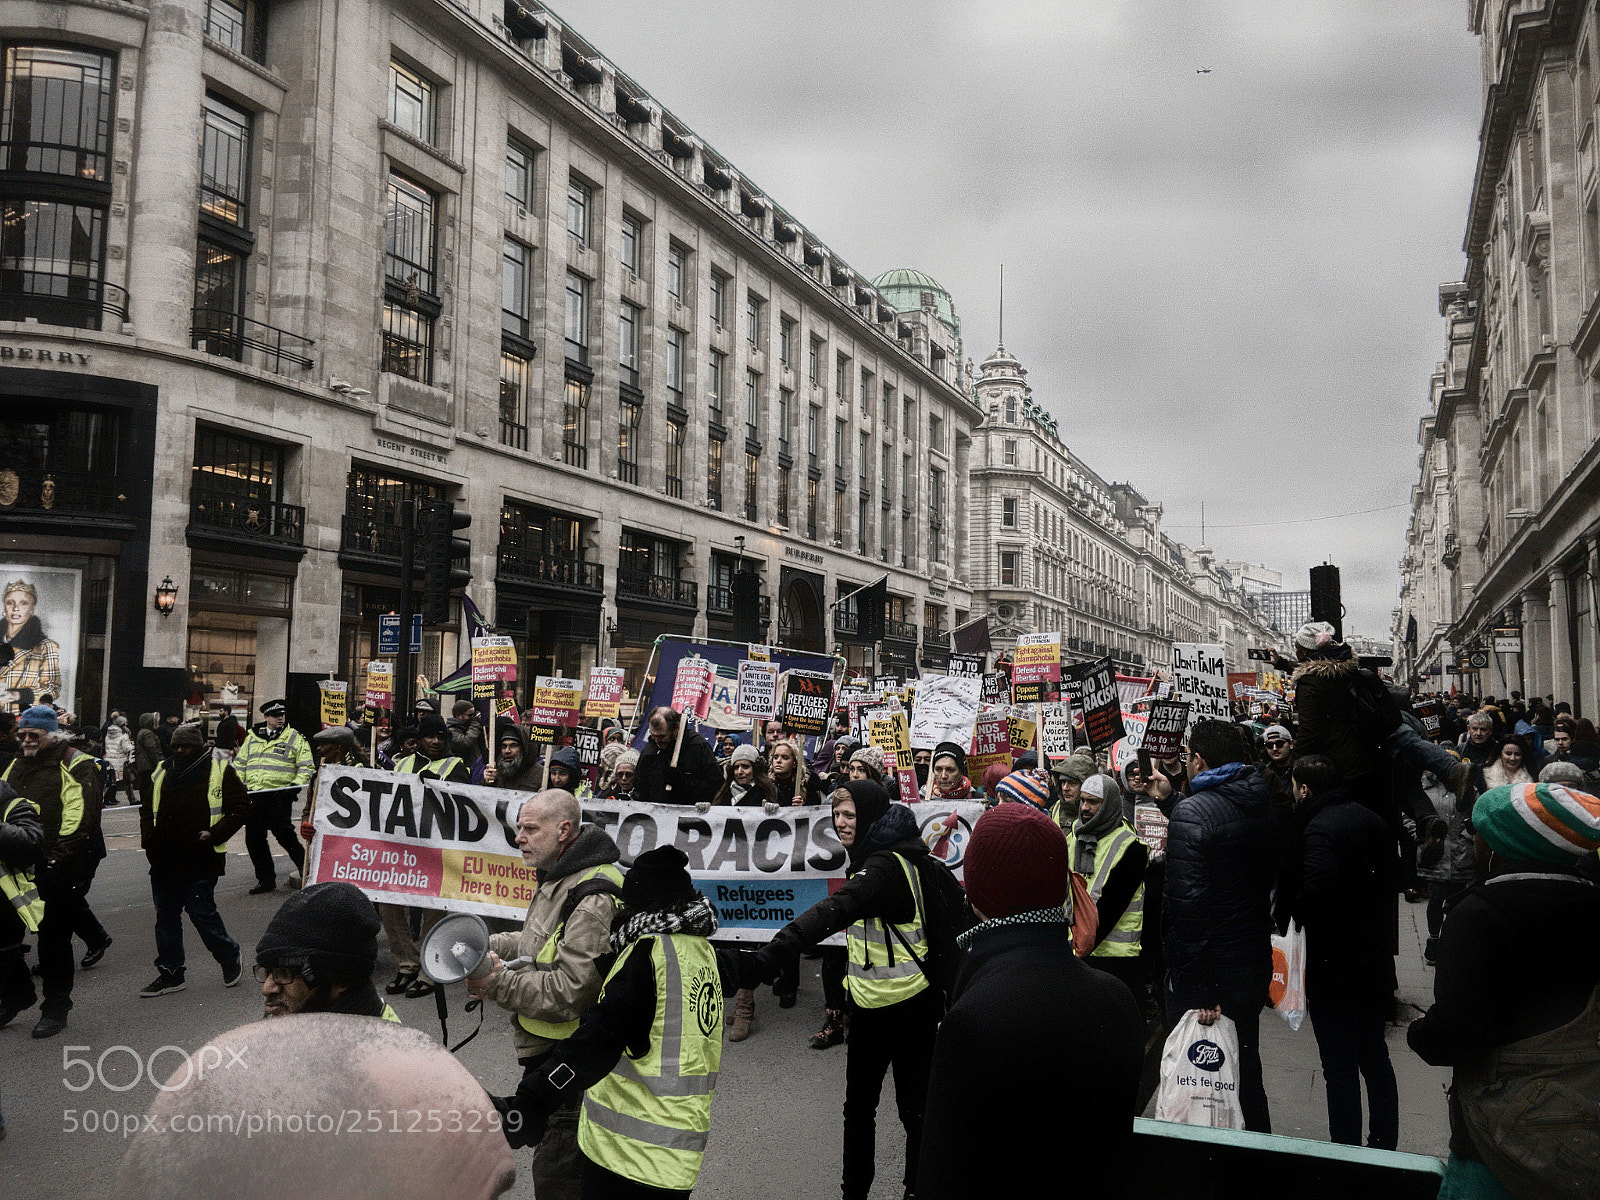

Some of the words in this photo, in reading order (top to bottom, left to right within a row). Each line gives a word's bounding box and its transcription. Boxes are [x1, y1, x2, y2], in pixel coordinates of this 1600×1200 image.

[377, 438, 406, 453] REGENT
[410, 447, 435, 461] STREET
[785, 546, 825, 565] BURBERRY
[1016, 647, 1030, 655] Fight
[1031, 646, 1053, 655] against
[1016, 654, 1055, 663] Islamophobia
[474, 666, 494, 674] Defend
[495, 665, 506, 673] civil
[949, 660, 963, 670] NO
[965, 661, 978, 672] TO
[1016, 665, 1037, 674] Defend
[1037, 665, 1050, 673] civil
[1215, 657, 1225, 677] 4
[474, 673, 497, 681] liberties
[699, 670, 709, 678] off
[948, 670, 983, 680] RACISM
[1016, 673, 1040, 682] liberties
[591, 676, 617, 685] HANDS
[686, 676, 712, 688] workers
[874, 681, 885, 690] NO
[1081, 677, 1096, 697] NO
[1098, 669, 1110, 689] TO
[474, 684, 495, 692] Oppose
[590, 684, 604, 692] OFF
[605, 685, 620, 693] THE
[680, 682, 709, 694] students
[684, 688, 703, 698] them
[748, 687, 772, 695] SERVICES
[1016, 685, 1039, 694] Oppose
[474, 691, 495, 699] Prevent
[536, 689, 551, 697] Fight
[553, 691, 574, 699] against
[588, 692, 611, 700] HIJAB
[1016, 693, 1039, 701] Prevent
[1083, 682, 1118, 713] RACISM
[535, 696, 574, 706] Islamophobia
[744, 695, 757, 704] NO
[758, 696, 770, 704] TO
[788, 693, 829, 708] REFUGEES
[534, 707, 555, 716] Defend
[556, 709, 569, 718] civil
[740, 704, 772, 713] RACISM
[786, 704, 827, 719] WELCOME
[1152, 705, 1188, 719] NEVER
[533, 715, 557, 724] liberties
[1006, 717, 1017, 726] OP
[1048, 720, 1068, 728] raising
[532, 726, 555, 735] Oppose
[794, 723, 820, 731] deportations
[873, 722, 892, 730] Migra
[977, 723, 1000, 734] NDS
[1124, 720, 1145, 734] NO
[530, 733, 554, 743] Prevent
[575, 734, 599, 750] VER
[986, 732, 1007, 742] THE
[1145, 734, 1157, 743] No
[1158, 735, 1168, 743] to
[977, 744, 996, 755] JAB
[1043, 741, 1069, 753] eard.
[577, 748, 599, 765] AIN!
[326, 775, 489, 843] STAND
[675, 816, 851, 874] RACIS
[1145, 825, 1168, 838] BRING
[351, 843, 378, 866] Say
[380, 850, 399, 865] no
[403, 850, 417, 867] to
[332, 860, 429, 889] Islamophobia
[463, 856, 484, 875] EU
[487, 862, 538, 883] workers
[460, 876, 492, 897] here
[495, 881, 509, 898] to
[716, 885, 795, 910] Refugees
[720, 902, 795, 921] welcome
[689, 976, 701, 1012] STAND
[1177, 1075, 1197, 1087] let's
